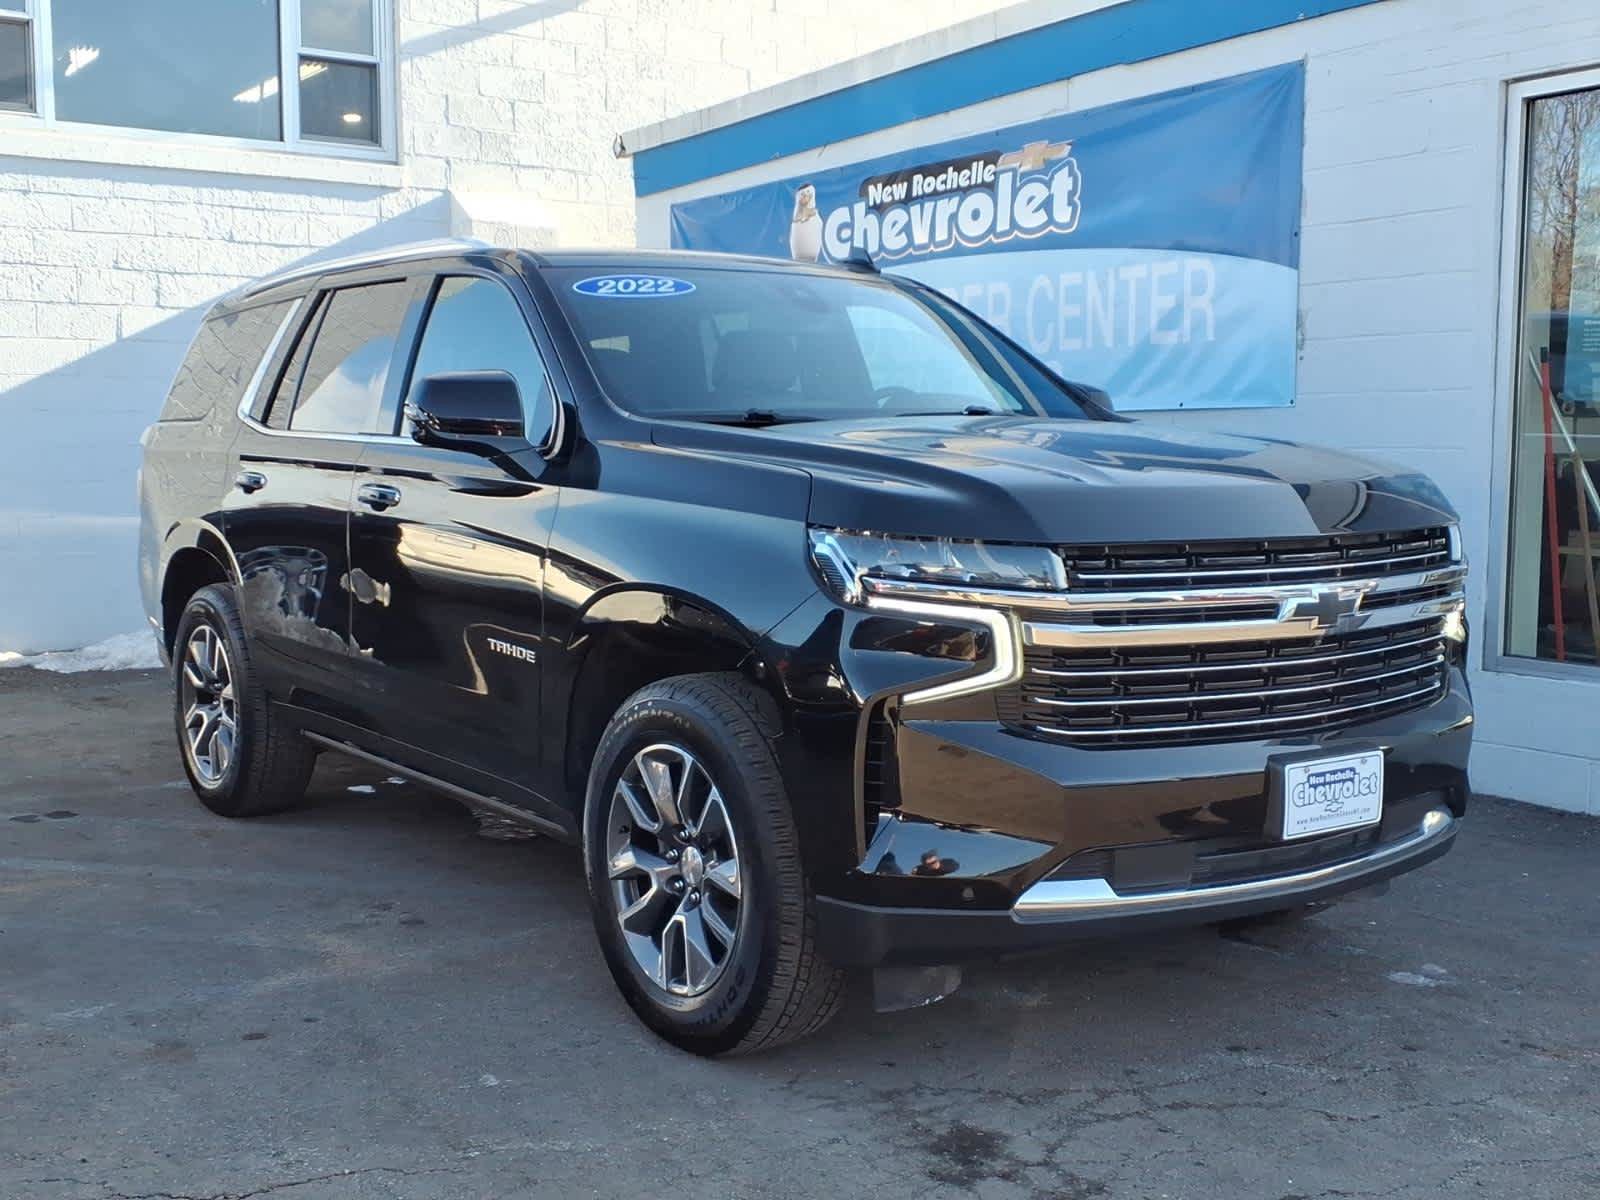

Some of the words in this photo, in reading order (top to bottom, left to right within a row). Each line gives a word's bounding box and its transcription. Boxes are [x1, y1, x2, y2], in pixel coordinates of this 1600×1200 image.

[868, 179, 908, 206] New
[911, 159, 997, 198] Rochelle
[822, 164, 1076, 261] Chevrolet
[597, 278, 676, 294] 2022
[1026, 258, 1216, 353] CENTER
[487, 638, 536, 663] TAHOE
[1292, 771, 1378, 807] Chevrolet
